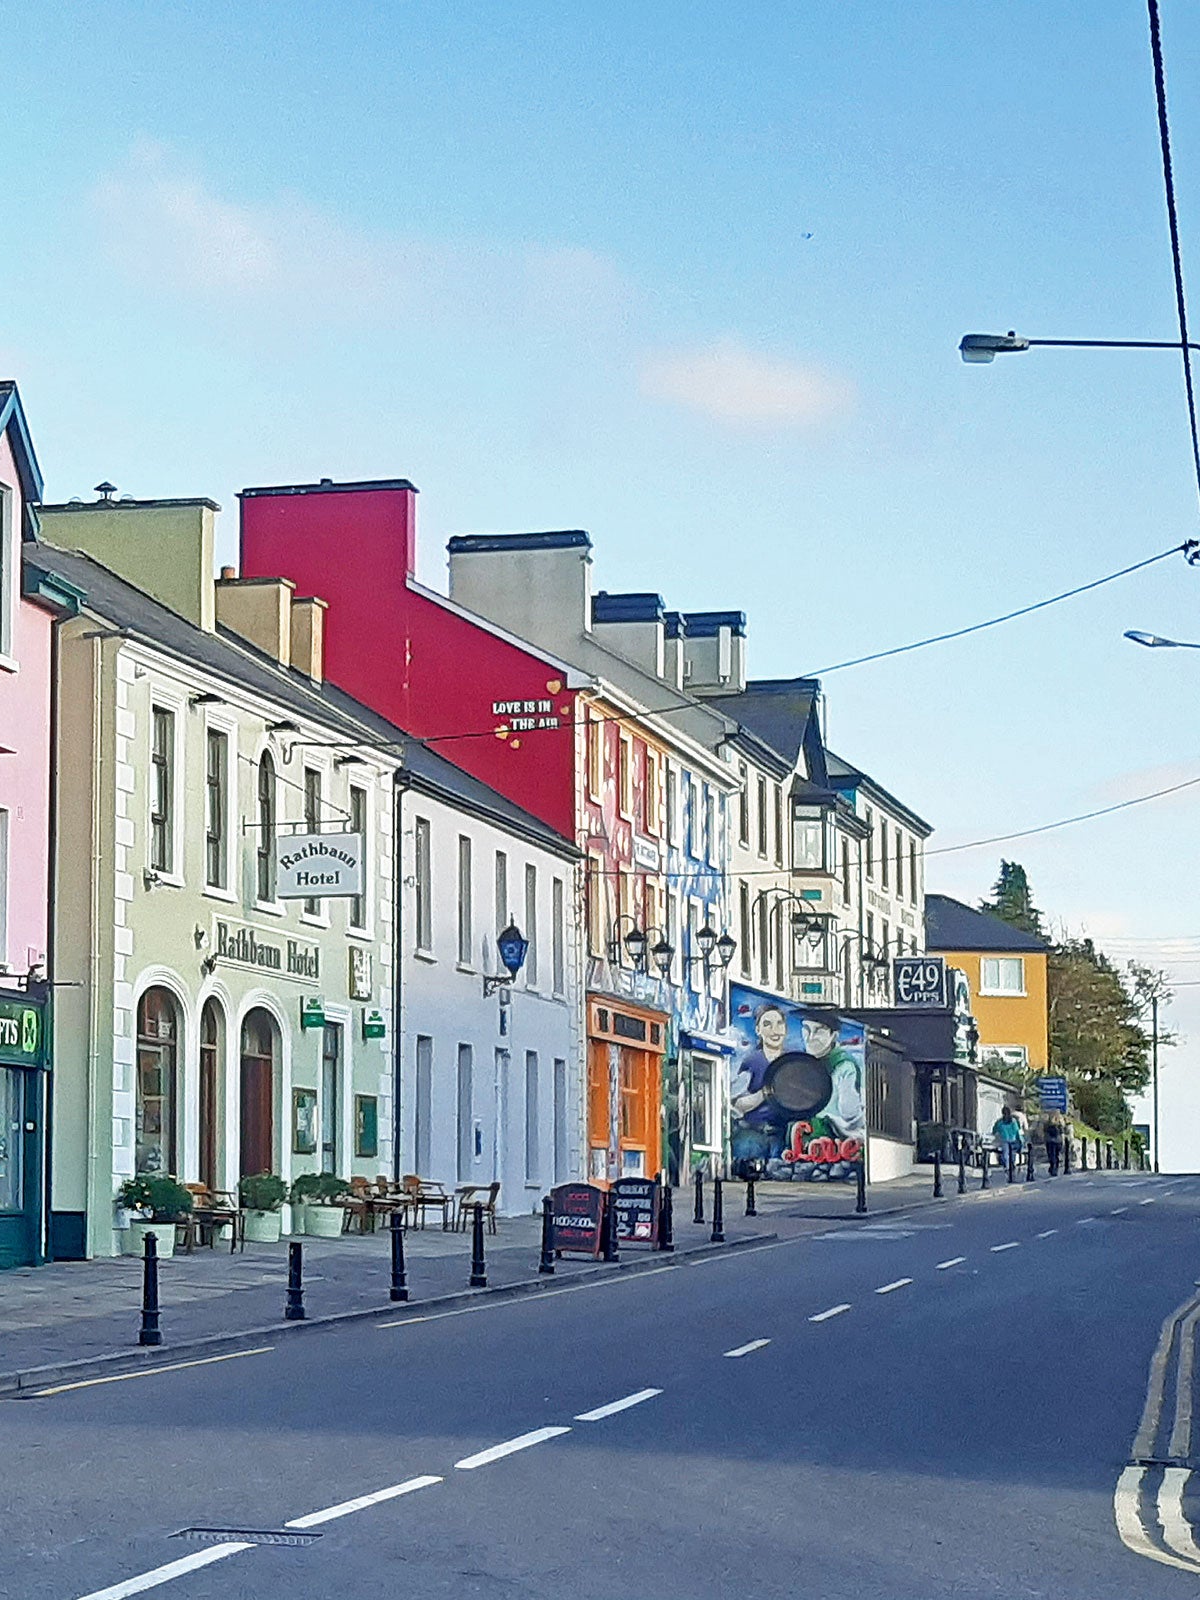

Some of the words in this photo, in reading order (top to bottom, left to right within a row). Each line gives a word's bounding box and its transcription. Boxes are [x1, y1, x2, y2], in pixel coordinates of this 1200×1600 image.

[493, 701, 521, 714] LOVE
[524, 701, 535, 713] IS
[538, 700, 551, 713] IN
[510, 718, 535, 730] THE
[538, 717, 558, 729] AIR
[279, 842, 357, 870] Rathbaun
[296, 870, 340, 886] Hotel
[216, 921, 282, 970] Rathbaun
[286, 938, 320, 979] Hotel
[898, 964, 939, 1001] €49
[781, 1120, 864, 1163] Love
